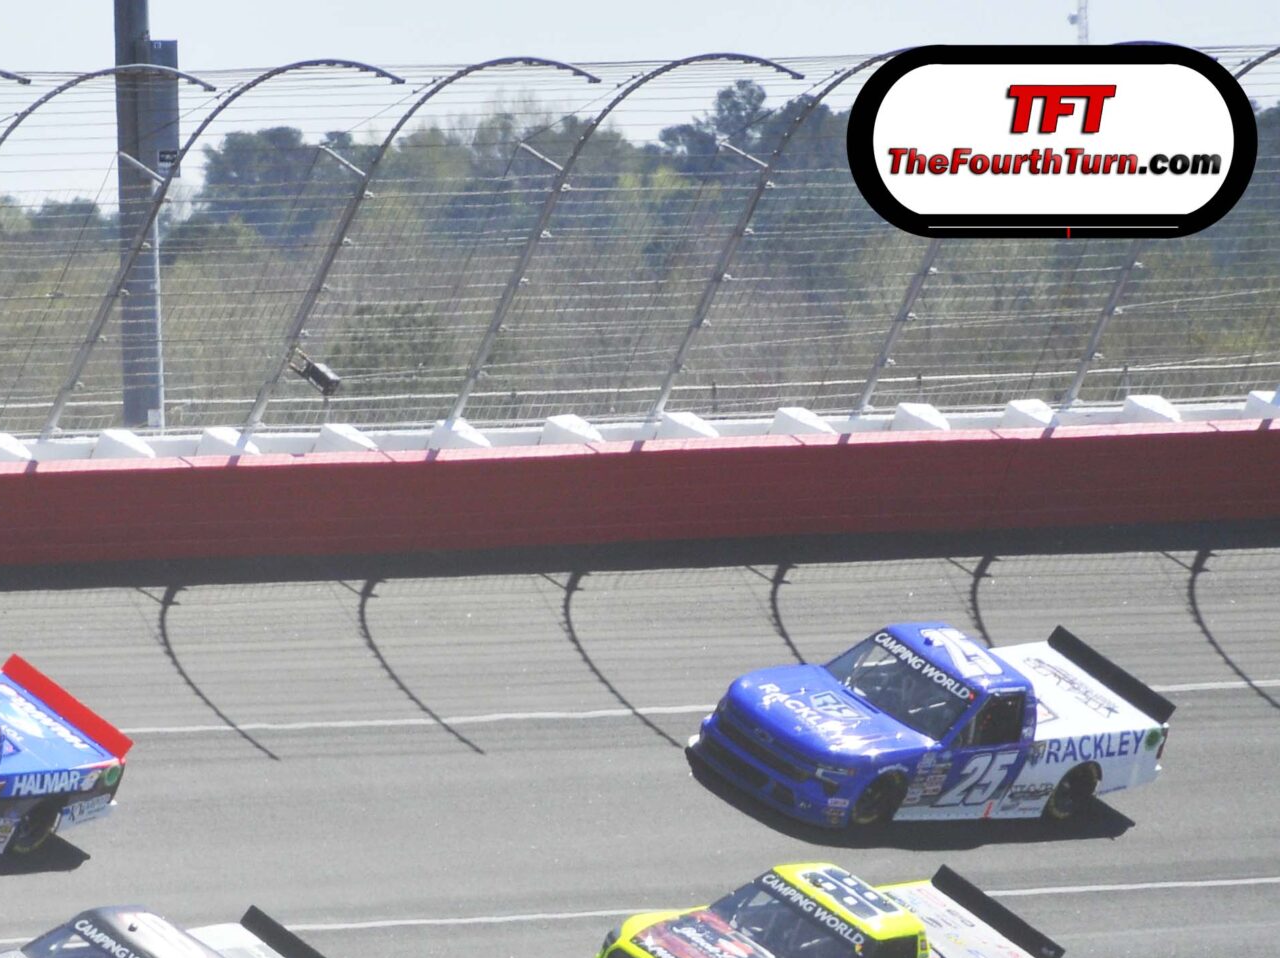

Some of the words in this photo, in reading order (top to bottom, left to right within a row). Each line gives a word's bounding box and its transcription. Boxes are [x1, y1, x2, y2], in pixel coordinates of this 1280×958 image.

[874, 632, 925, 670] CAMPING
[921, 664, 970, 700] WORLD
[1045, 729, 1146, 764] RACKLEY
[11, 771, 81, 797] HALMAR
[930, 750, 1019, 807] 25
[762, 874, 817, 912] CAMPING
[813, 906, 865, 945] WORLD
[800, 868, 902, 920] 88
